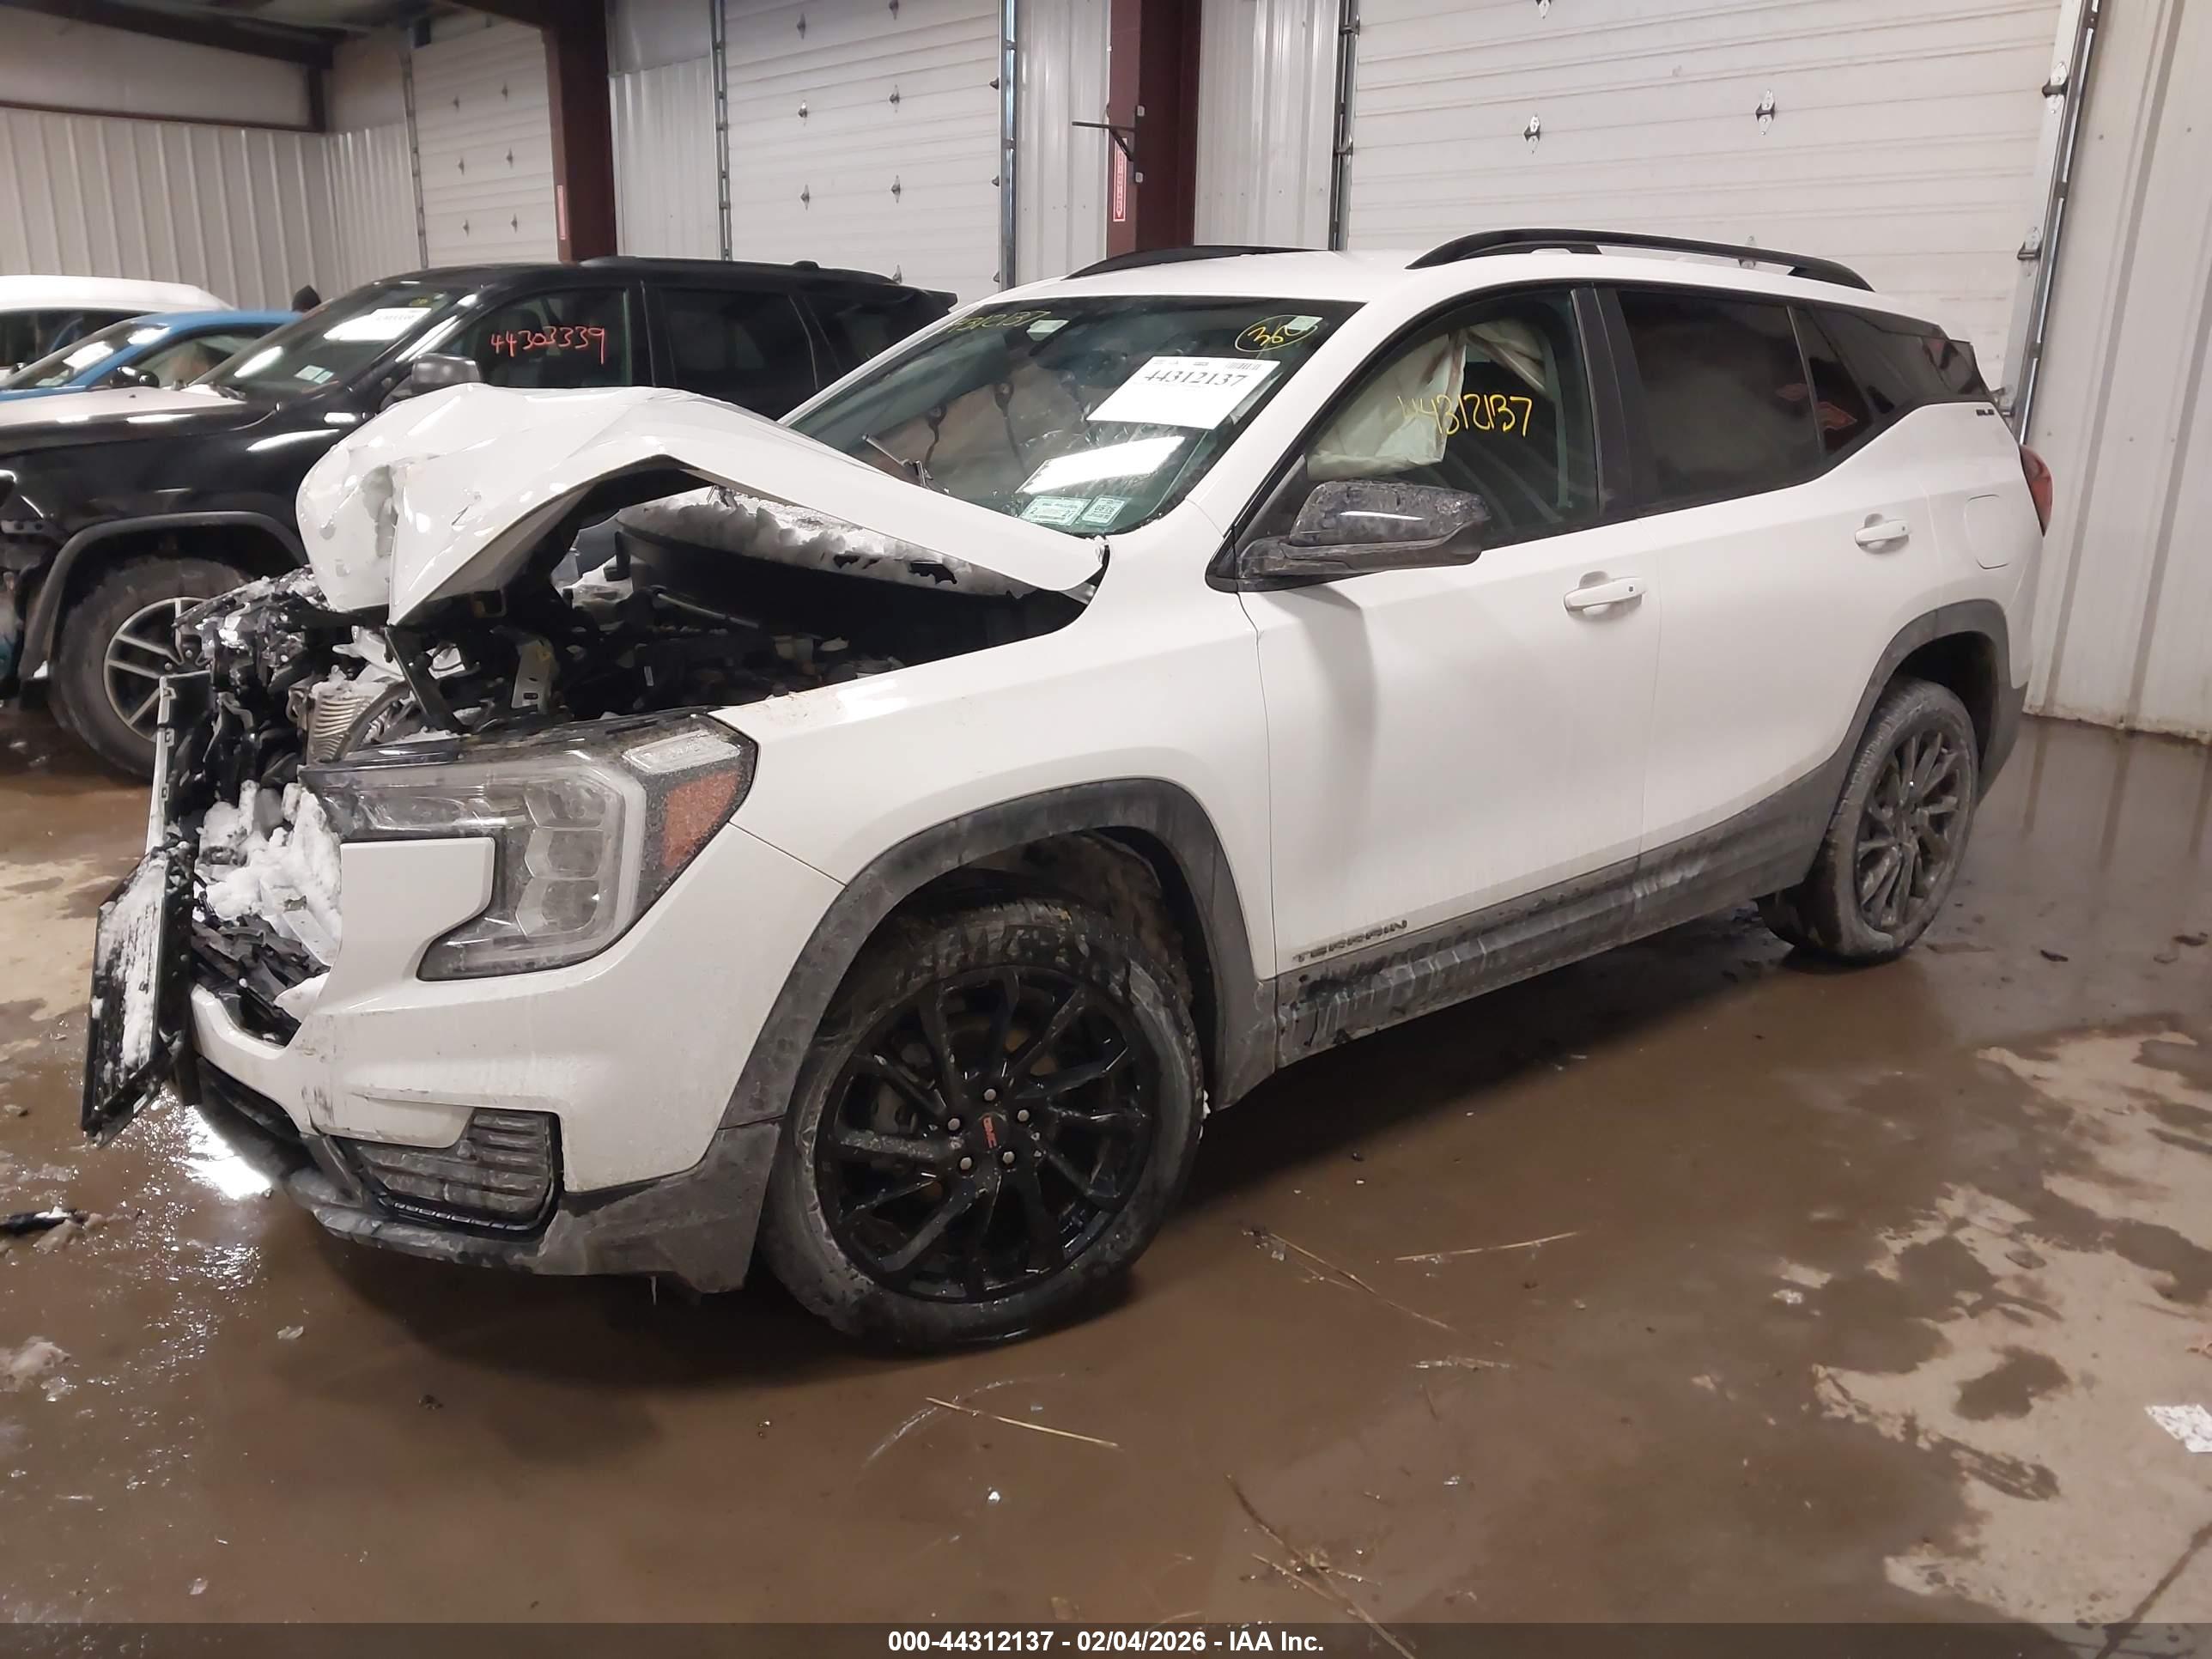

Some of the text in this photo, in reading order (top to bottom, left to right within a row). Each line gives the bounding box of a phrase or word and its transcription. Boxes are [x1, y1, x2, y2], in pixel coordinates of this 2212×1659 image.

[490, 325, 605, 365] 44303339
[1144, 369, 1249, 387] 44312137
[1397, 393, 1533, 438] 44312137
